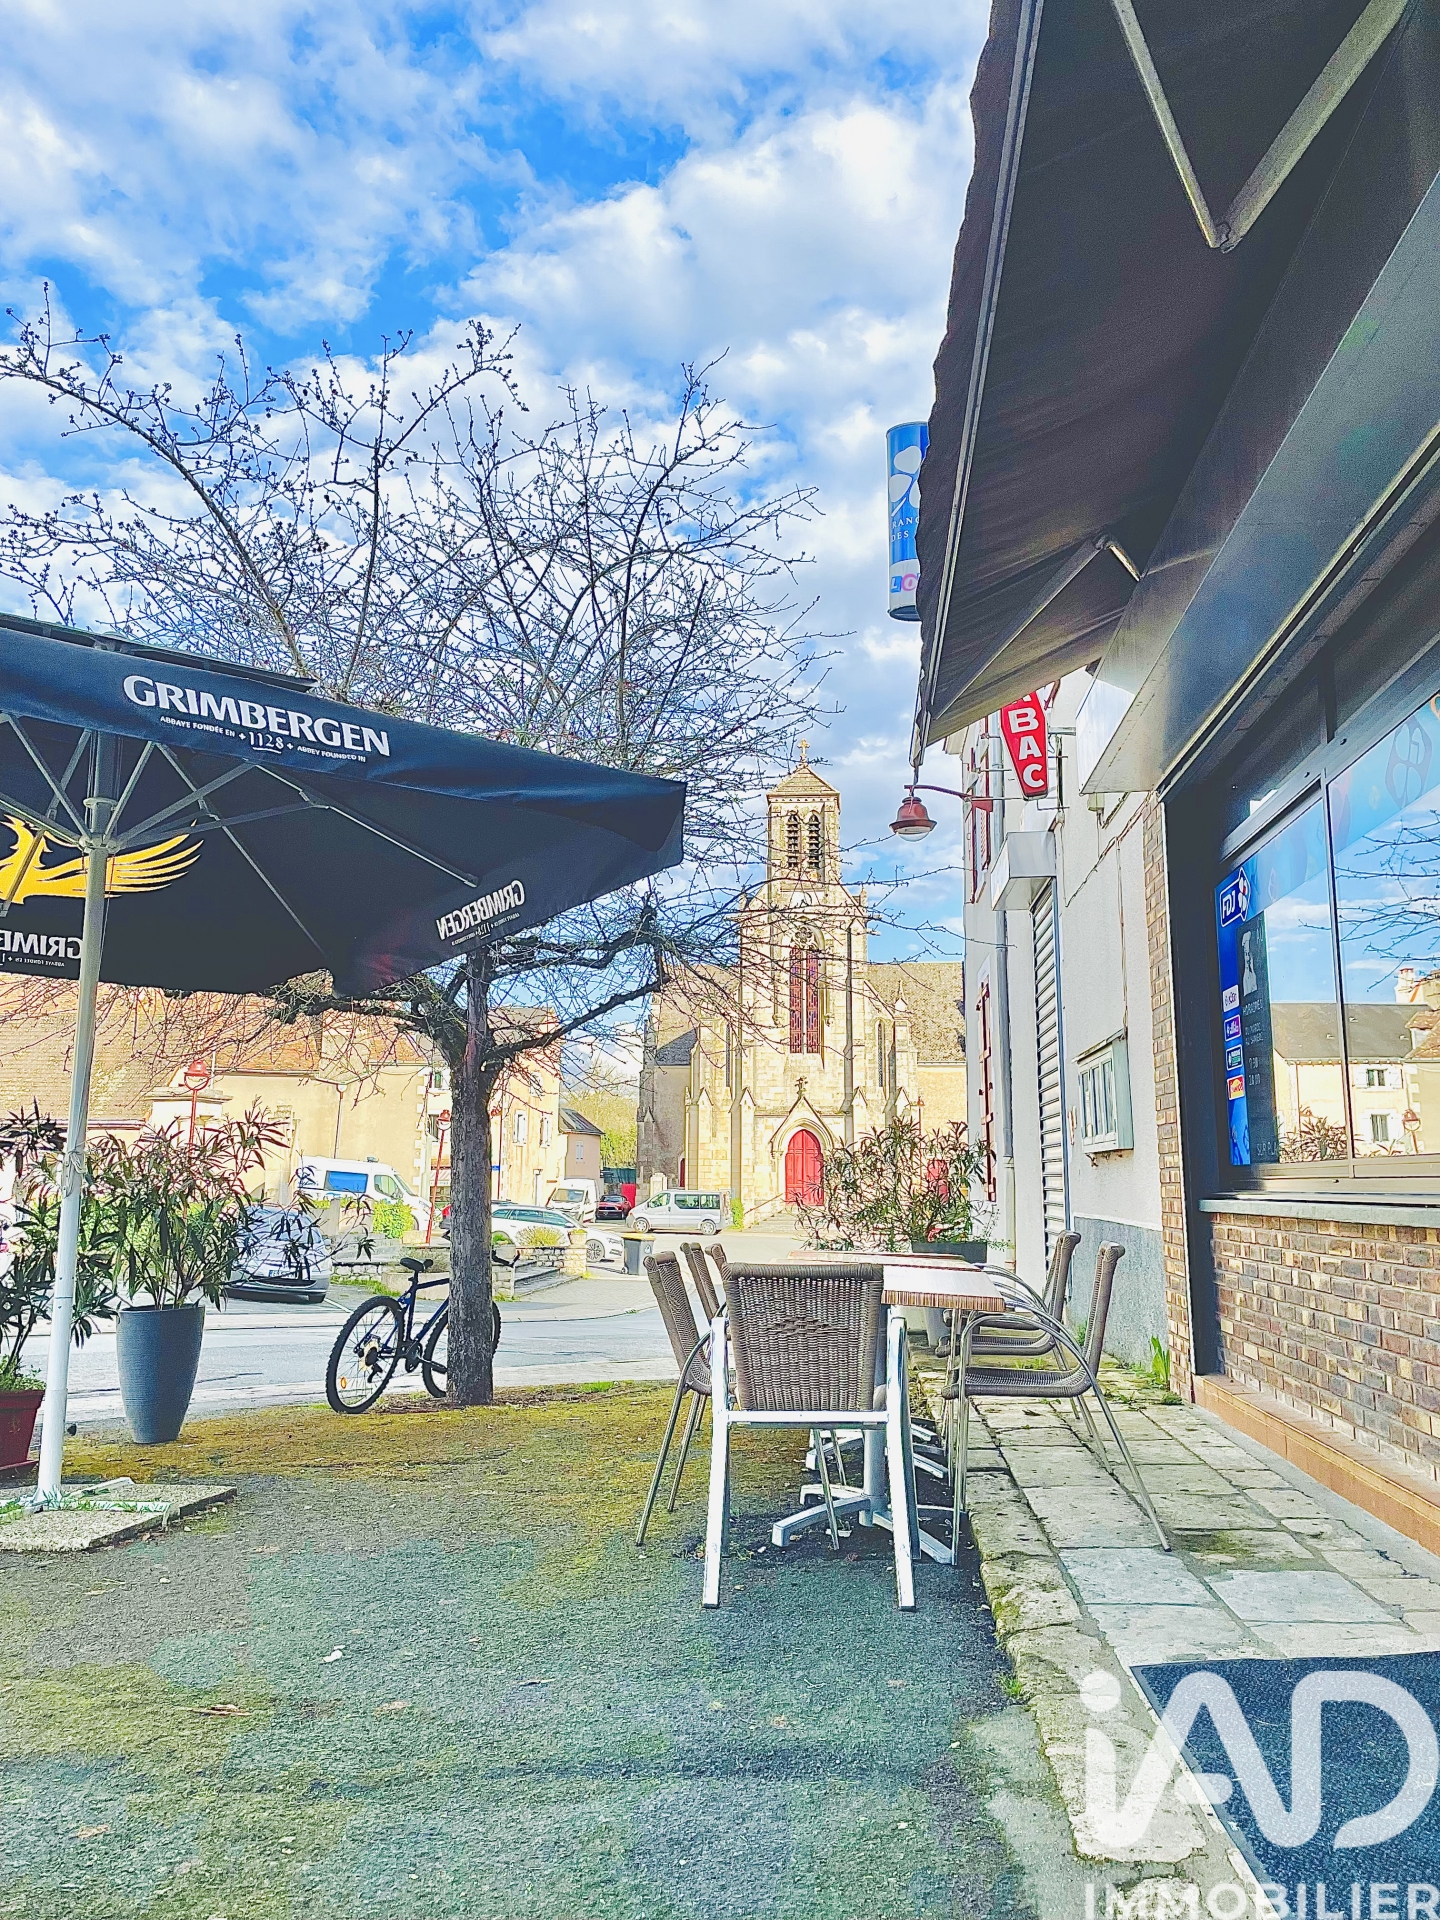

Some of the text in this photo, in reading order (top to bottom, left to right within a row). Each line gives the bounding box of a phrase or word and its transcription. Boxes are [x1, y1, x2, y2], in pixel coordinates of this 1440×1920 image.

[891, 573, 921, 593] LO
[123, 675, 390, 757] GRIMBERGEN
[160, 715, 366, 763] ABBAYE FONDÉE EN 1128 ABBEY FOUNDED IN
[1008, 694, 1045, 788] BAC
[1222, 890, 1236, 919] FDJ
